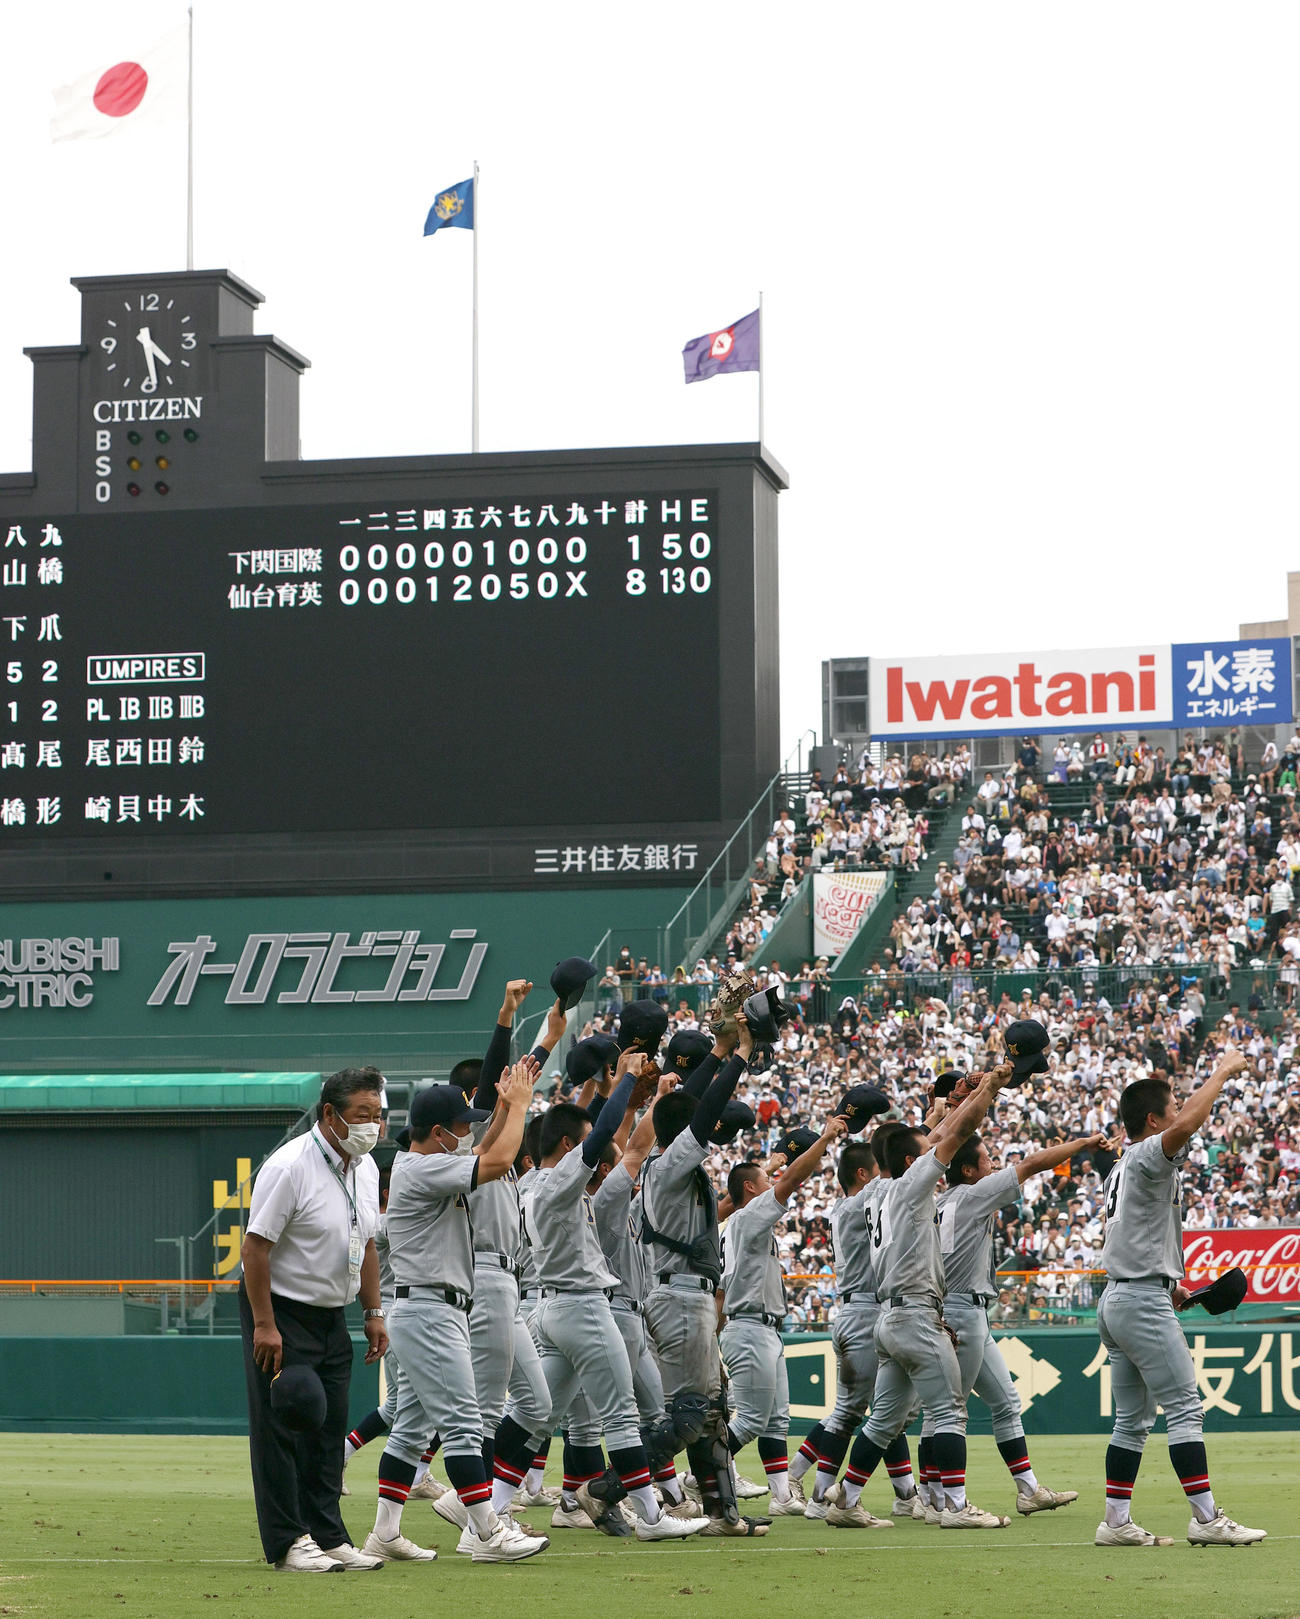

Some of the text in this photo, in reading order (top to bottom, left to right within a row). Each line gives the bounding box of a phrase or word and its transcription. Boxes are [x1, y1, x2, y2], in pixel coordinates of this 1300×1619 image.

[140, 293, 160, 311] 12
[100, 336, 117, 355] 9
[181, 332, 197, 350] 3
[93, 396, 203, 423] CITIZEN
[228, 547, 323, 575] 下関国際
[227, 582, 322, 610] 仙台育英
[625, 568, 647, 596] 8
[6, 659, 58, 684] 5 2
[95, 657, 197, 680] UMPIRES
[1187, 648, 1275, 695] 水素
[887, 655, 1155, 722] Iwatani
[41, 699, 58, 722] 2
[86, 698, 111, 722] PL
[1187, 696, 1276, 718] エネルギー
[533, 843, 699, 873] 三井住友銀行
[0, 936, 120, 972] UBISHI
[146, 929, 489, 1006] オーロラビジョン
